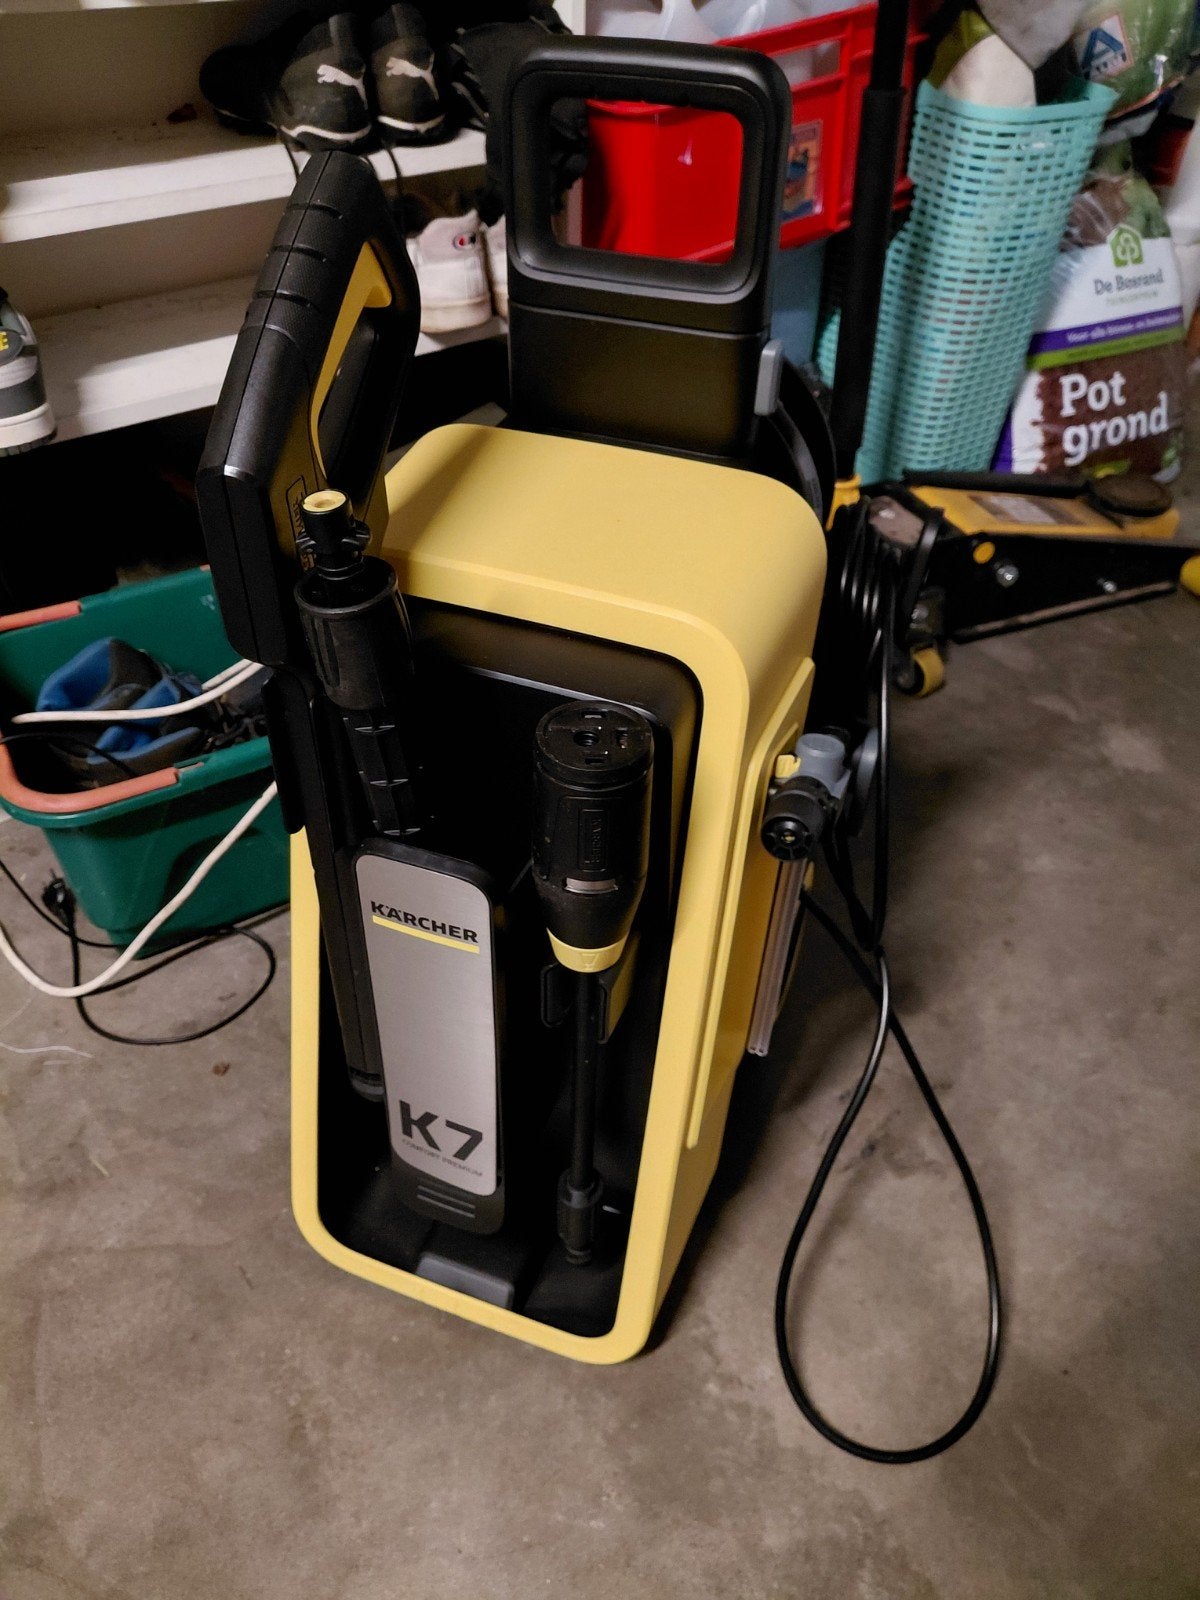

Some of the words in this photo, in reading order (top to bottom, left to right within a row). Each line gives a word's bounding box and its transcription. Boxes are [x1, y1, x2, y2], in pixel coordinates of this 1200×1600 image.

[1094, 278, 1113, 296] De
[1059, 371, 1126, 417] Pot
[1062, 390, 1169, 467] grond
[370, 900, 479, 943] KÄRCHER
[399, 1099, 483, 1161] K7
